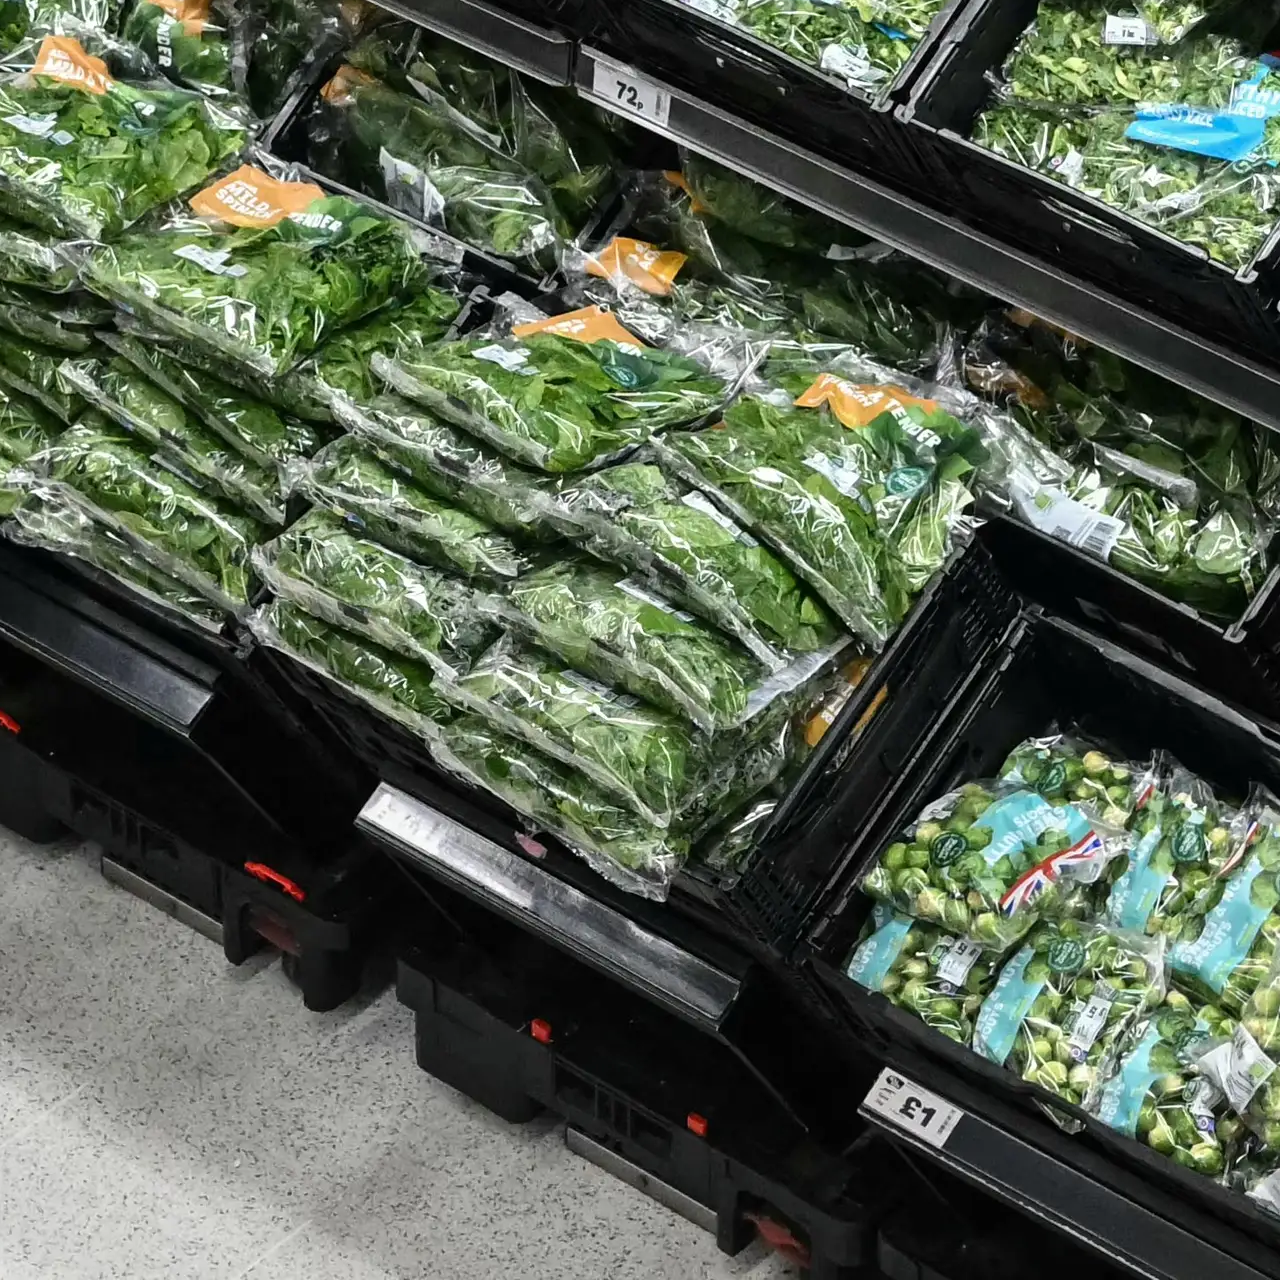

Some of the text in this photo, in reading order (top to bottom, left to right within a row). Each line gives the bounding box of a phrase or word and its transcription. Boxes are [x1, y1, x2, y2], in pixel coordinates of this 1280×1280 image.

[616, 78, 644, 111] 72p
[884, 397, 942, 449] TENDER
[898, 1095, 937, 1138] £1
